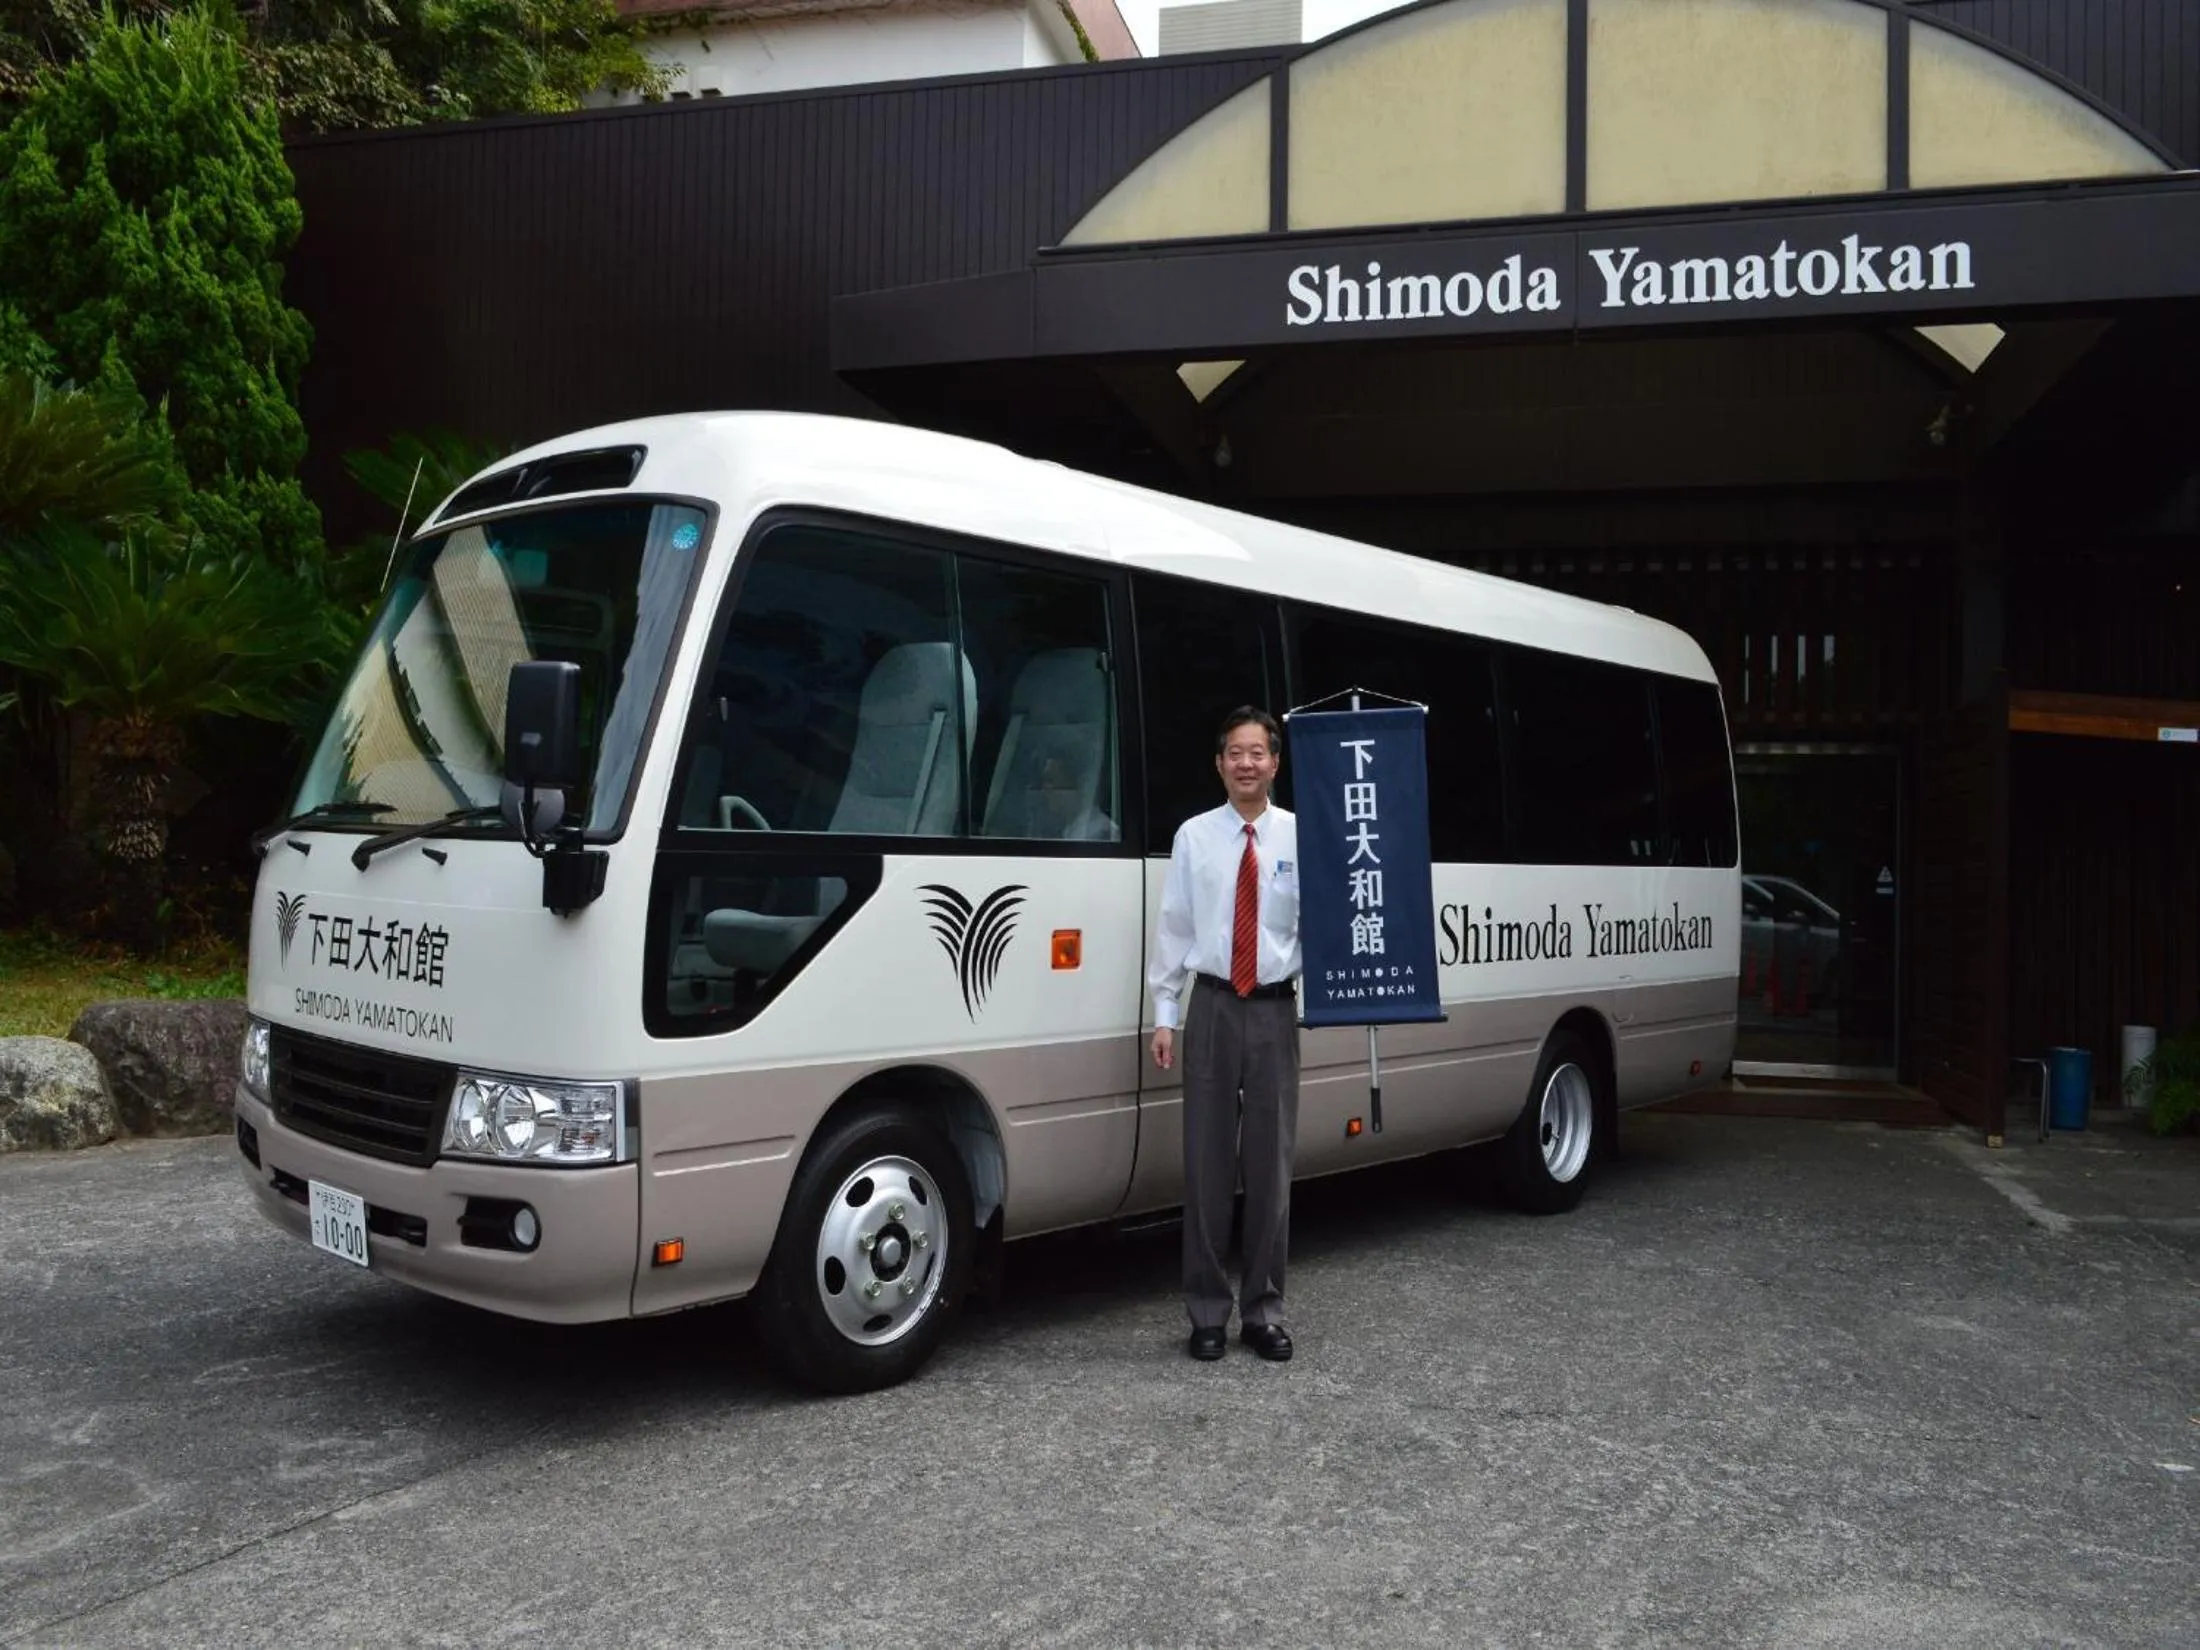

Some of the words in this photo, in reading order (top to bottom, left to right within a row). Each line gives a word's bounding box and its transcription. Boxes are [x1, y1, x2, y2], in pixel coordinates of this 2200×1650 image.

[1286, 254, 1561, 326] Shimoda
[1589, 234, 1975, 308] Yamatokan
[1340, 738, 1385, 955] 下田大和館
[308, 914, 449, 988] 下田大和館
[1439, 903, 1572, 965] Shimoda
[1583, 901, 1713, 957] Yamatokan
[1325, 965, 1414, 981] SHIMODA
[1327, 985, 1415, 1000] YAMATOKAN
[295, 987, 351, 1023] SHIMODA
[354, 998, 454, 1043] YAMATOKAN
